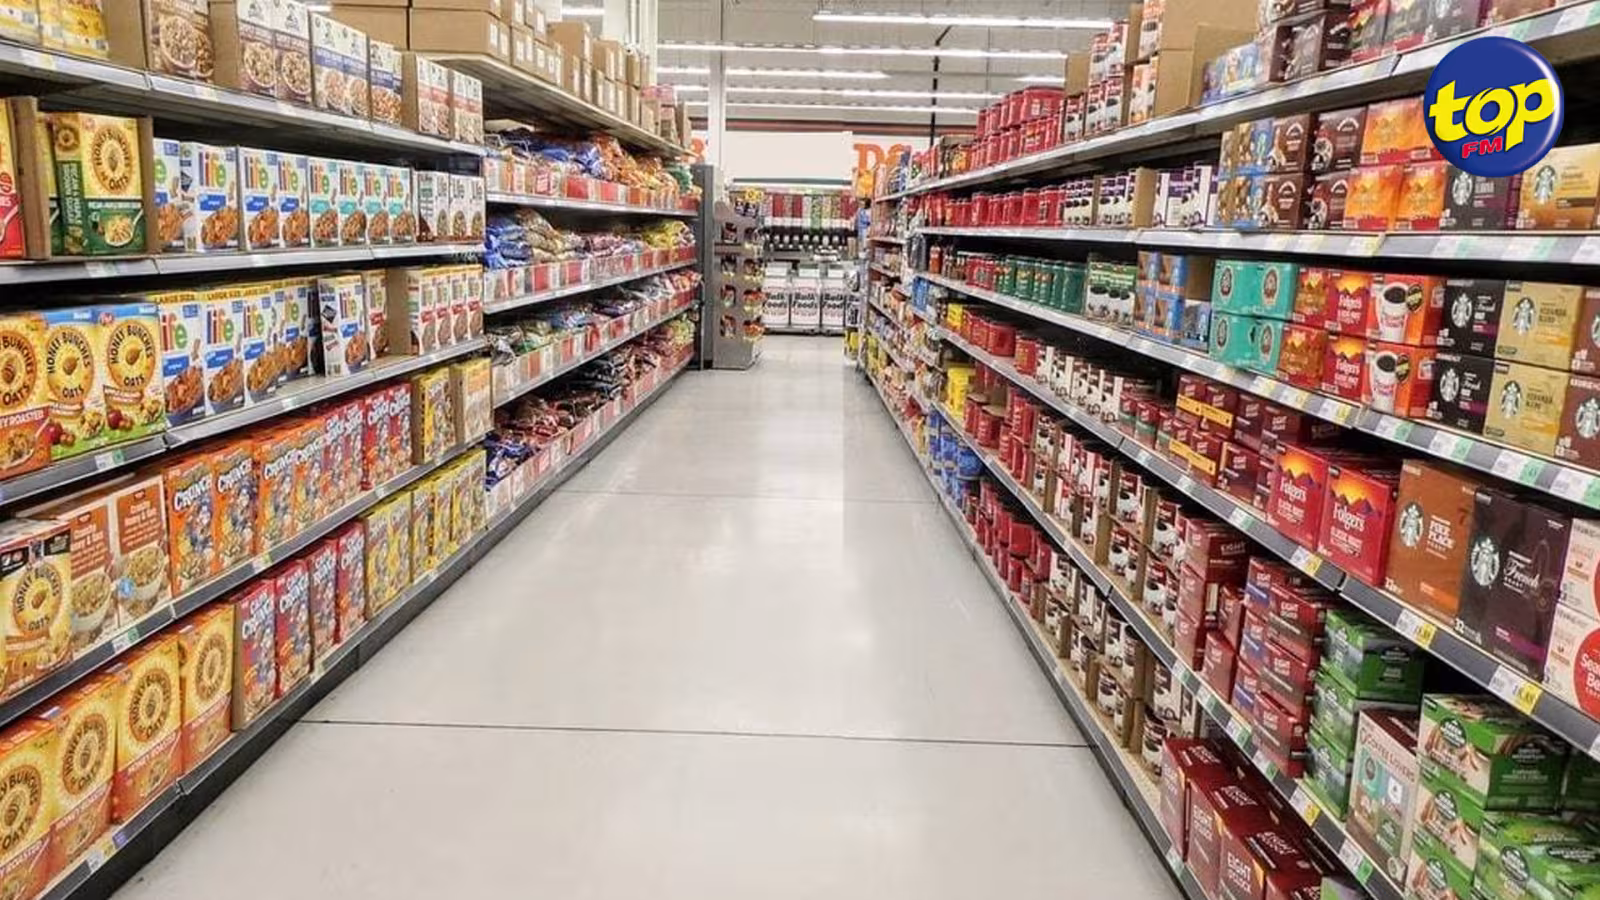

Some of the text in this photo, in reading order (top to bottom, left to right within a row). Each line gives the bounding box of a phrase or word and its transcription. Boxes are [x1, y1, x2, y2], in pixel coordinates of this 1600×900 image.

[109, 173, 129, 190] OATS
[199, 151, 226, 188] life
[244, 157, 268, 189] life
[278, 160, 298, 191] life
[310, 164, 329, 194] life
[340, 166, 358, 196] life
[793, 301, 818, 309] Foods
[795, 292, 815, 300] Bulk
[162, 313, 188, 352] ife
[206, 309, 235, 345] life
[243, 304, 265, 339] life
[46, 331, 91, 374] HONEY BUNCHES
[110, 325, 153, 365] HONEY BUNCHES
[3, 382, 30, 406] OATS
[62, 385, 85, 399] OATS
[123, 374, 145, 387] OATS
[1280, 476, 1307, 503] Folgers
[1333, 501, 1365, 532] Folgers
[1428, 530, 1455, 549] PLACE
[1503, 557, 1541, 590] French
[17, 574, 32, 613] HONEY
[28, 614, 50, 631] OATS
[63, 727, 82, 776] HONEY
[3, 817, 32, 849] OATS
[1227, 851, 1251, 878] EIGHT
